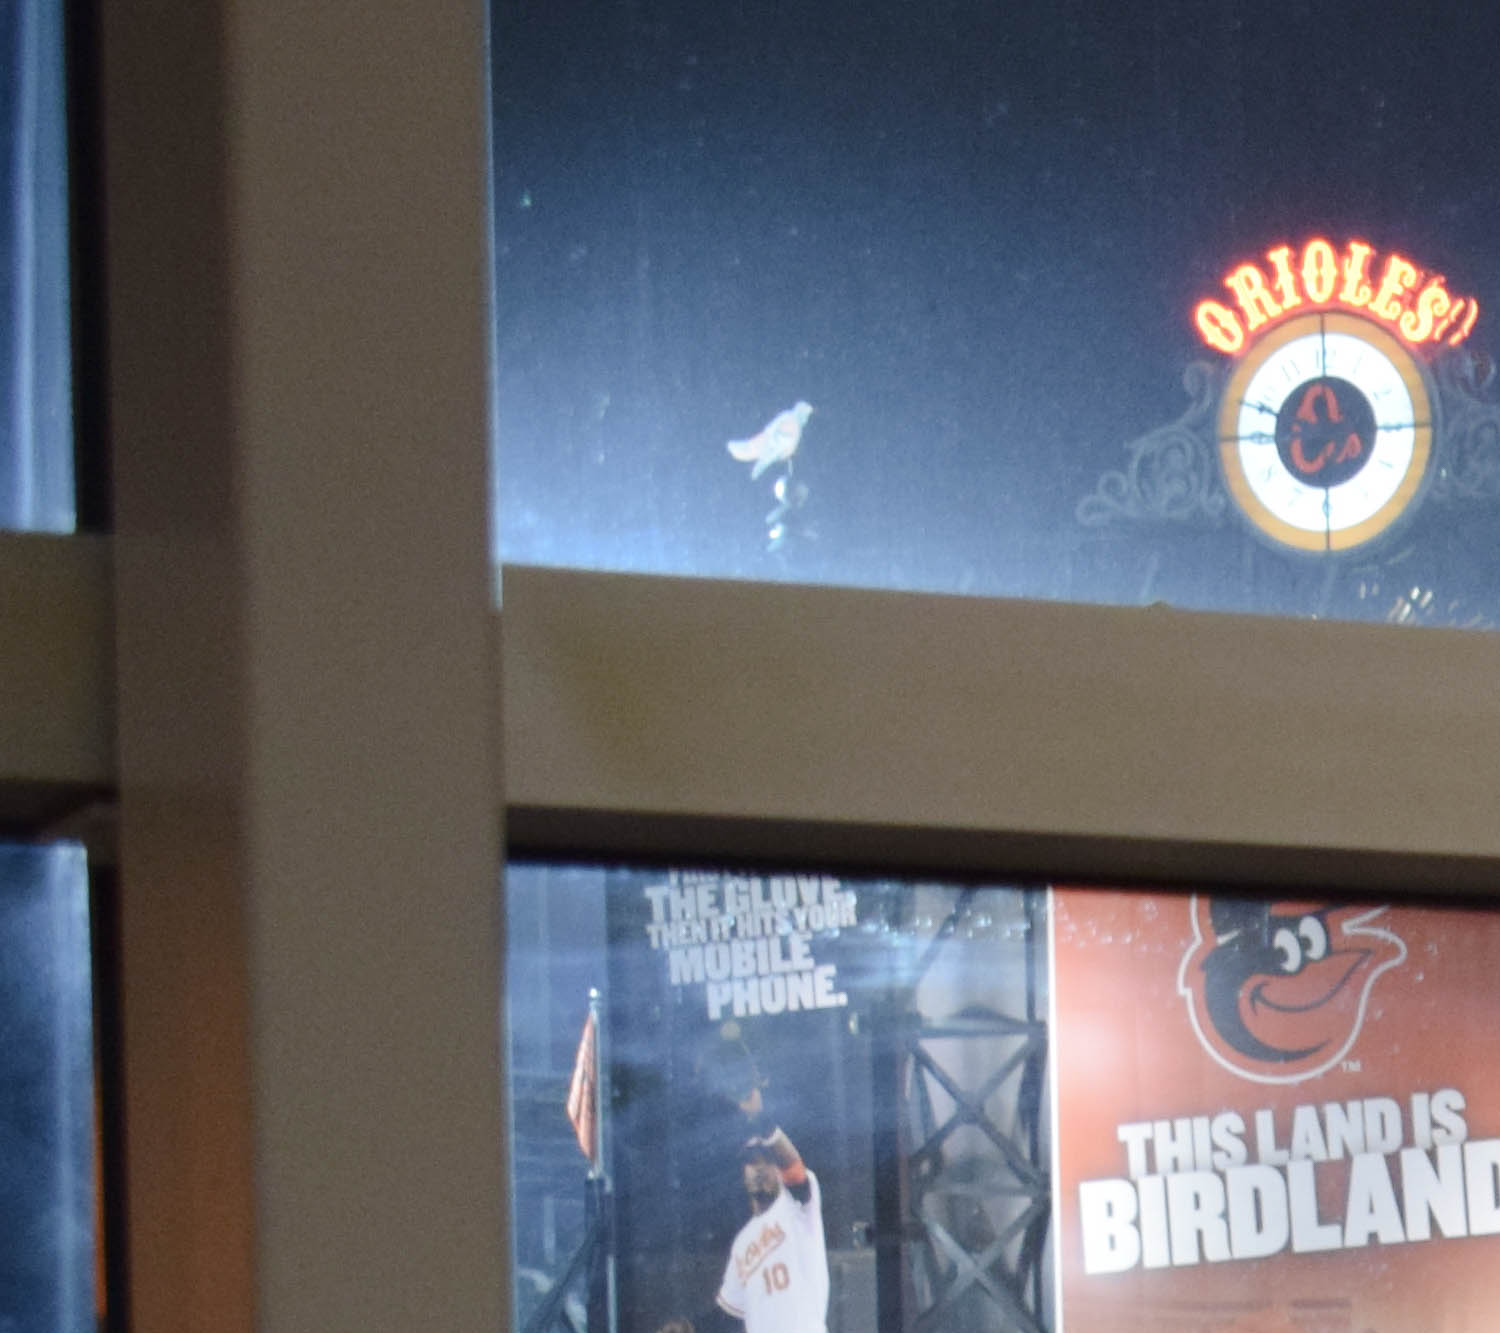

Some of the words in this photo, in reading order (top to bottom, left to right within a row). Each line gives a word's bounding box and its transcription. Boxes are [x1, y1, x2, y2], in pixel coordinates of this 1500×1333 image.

[644, 884, 720, 923] THE
[669, 931, 815, 985] MOBILE
[707, 964, 848, 1020] PHONE.
[1118, 1111, 1247, 1178] THIS
[1255, 1097, 1403, 1167] LAND
[1411, 1088, 1468, 1150] IS
[762, 1262, 791, 1296] 10
